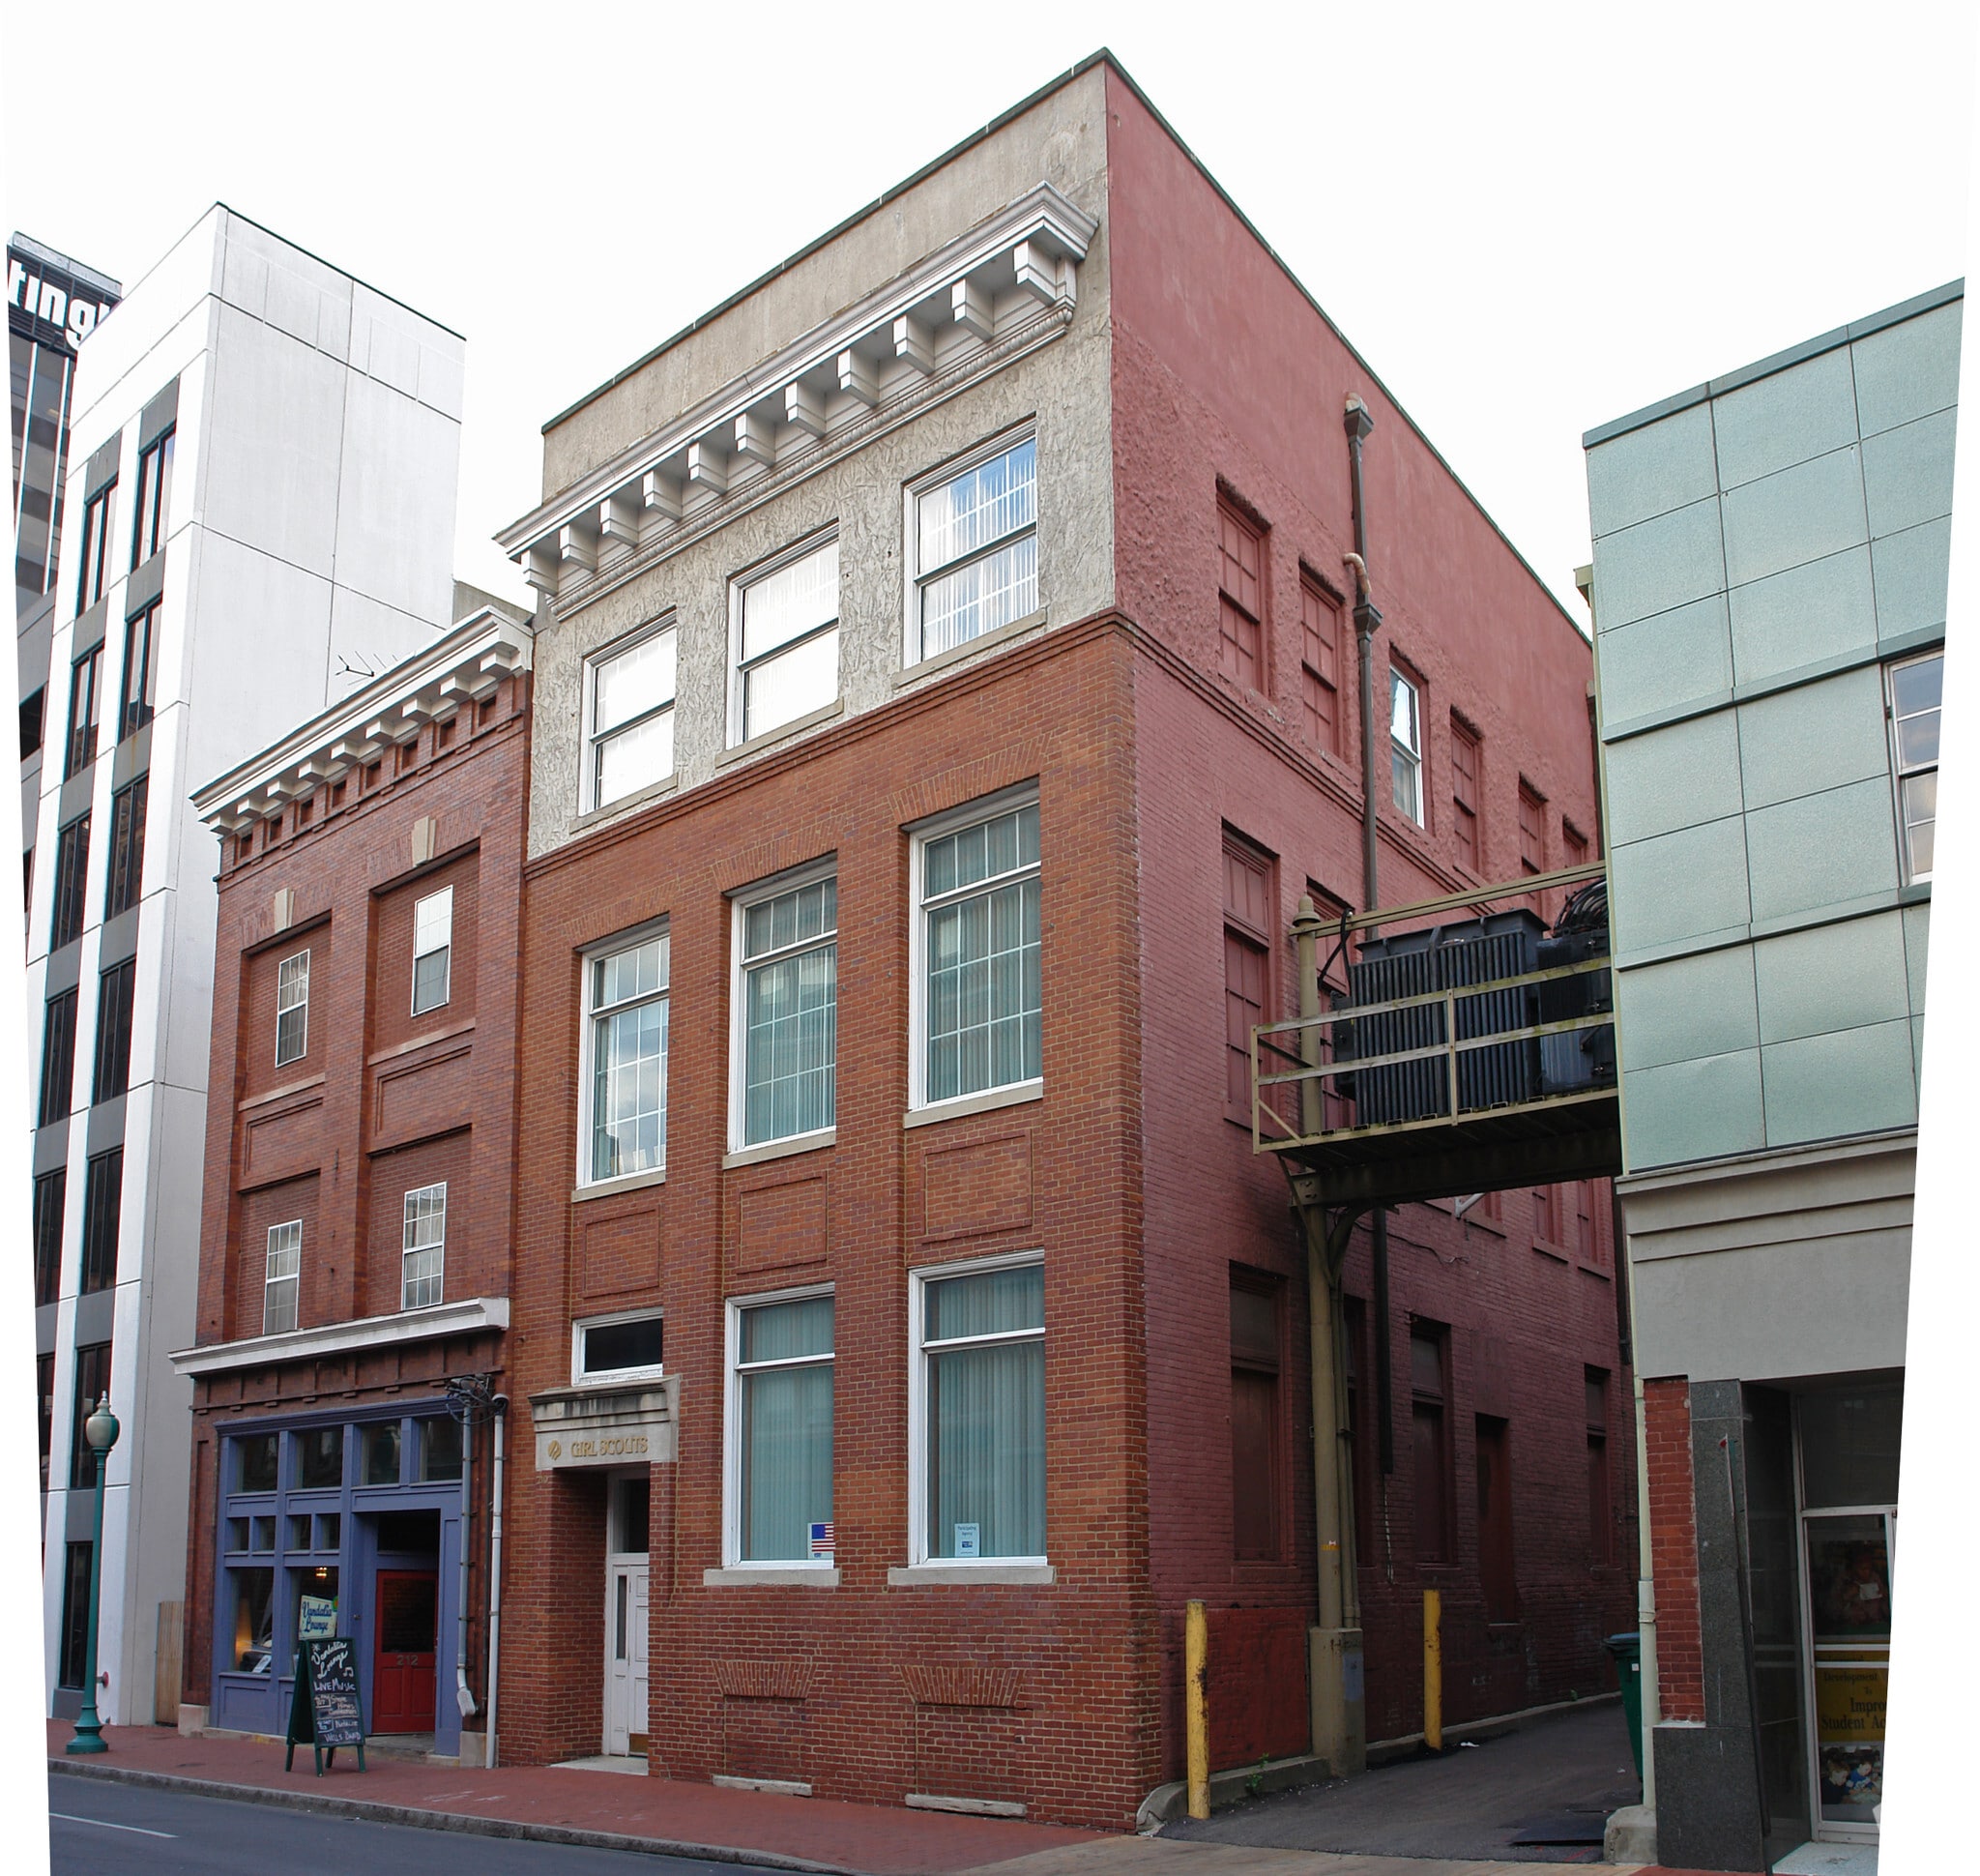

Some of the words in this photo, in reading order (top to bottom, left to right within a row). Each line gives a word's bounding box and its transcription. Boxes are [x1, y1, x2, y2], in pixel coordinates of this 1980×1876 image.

[570, 1440, 597, 1457] GIRL
[599, 1435, 649, 1456] SCOUTS
[302, 1600, 333, 1619] Vandalia
[304, 1614, 329, 1634] Lounge
[396, 1655, 419, 1666] 212
[1823, 1671, 1878, 1685] Development
[1849, 1697, 1886, 1717] Impro
[1821, 1715, 1865, 1730] Student
